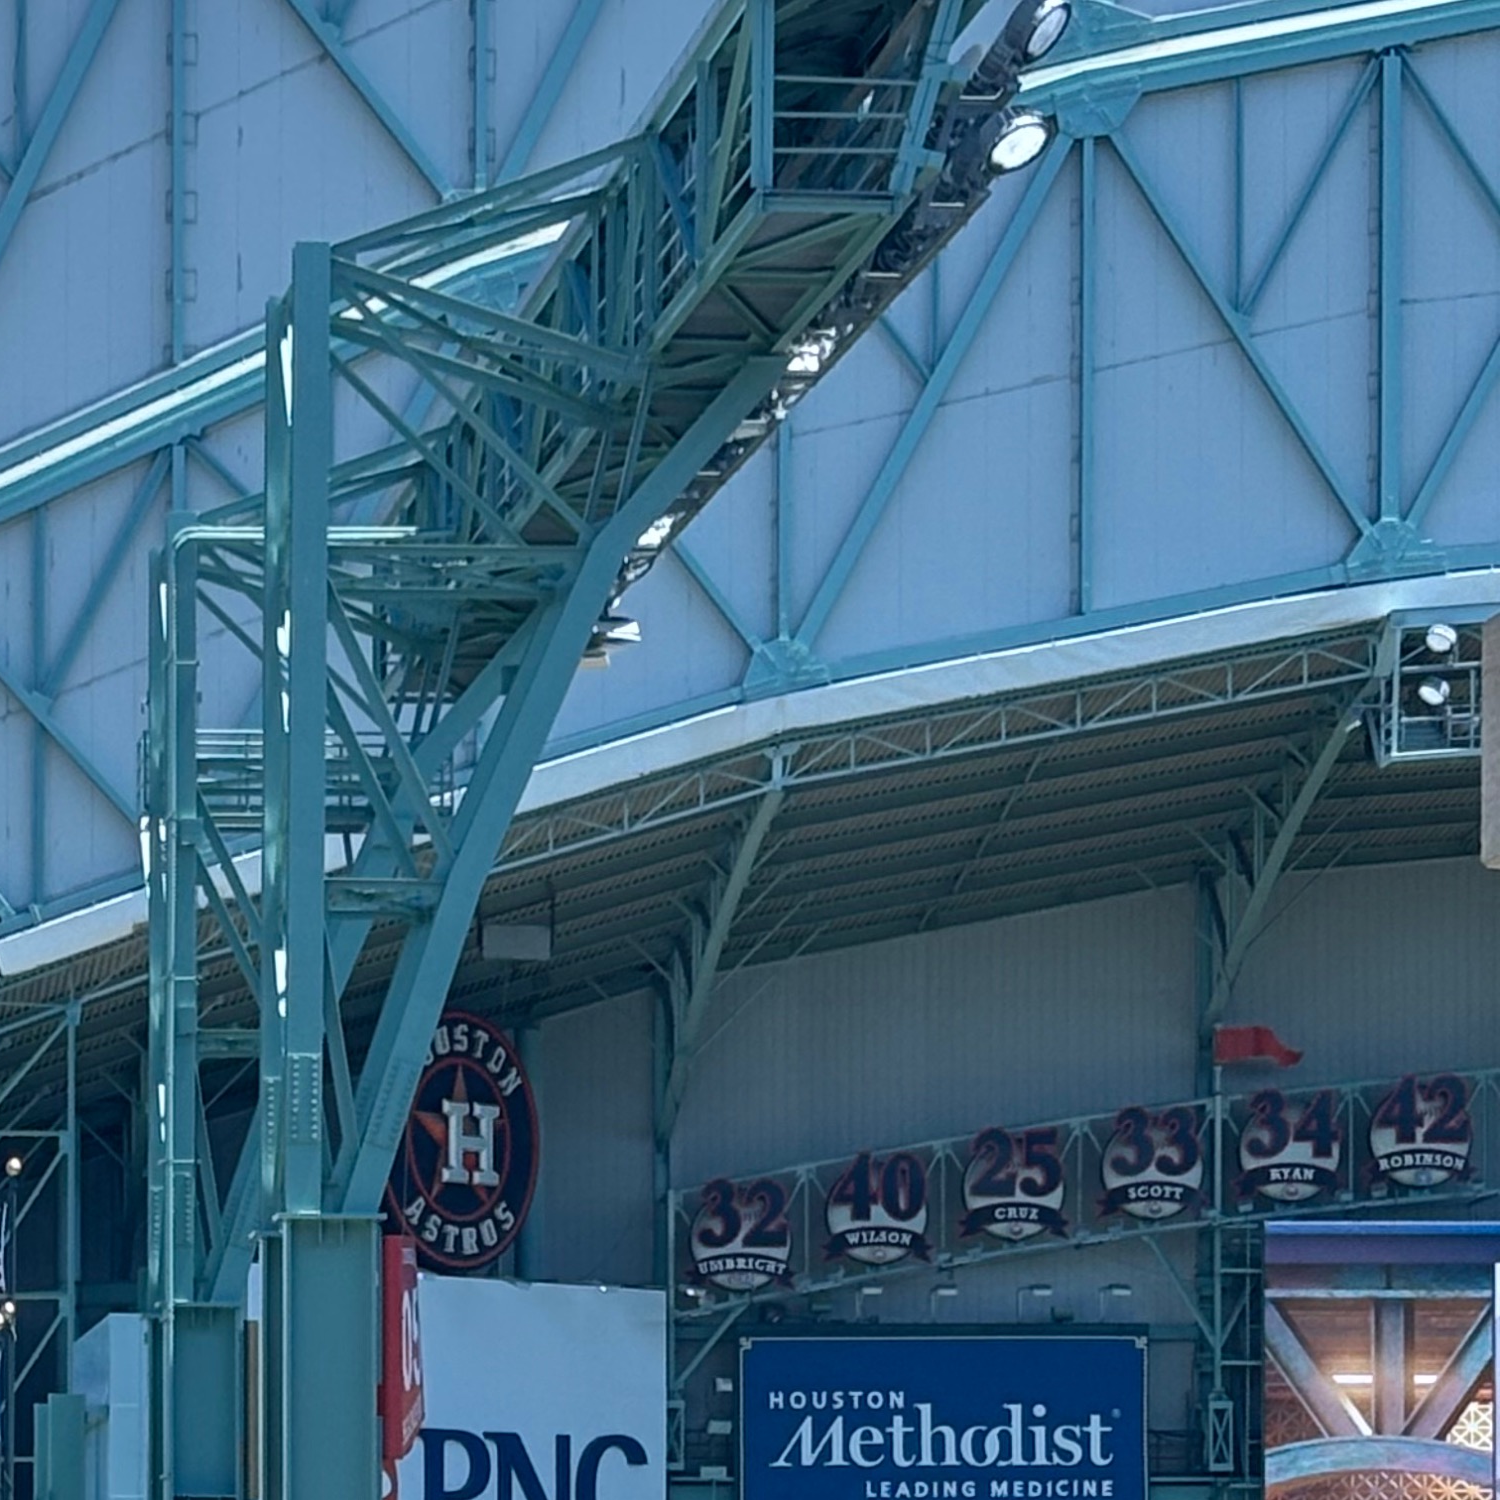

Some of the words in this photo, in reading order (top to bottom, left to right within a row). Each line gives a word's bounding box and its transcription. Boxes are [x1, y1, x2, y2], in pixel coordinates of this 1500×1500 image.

[424, 1024, 522, 1096] USTON
[1110, 1106, 1199, 1177] 33
[1246, 1088, 1340, 1158] 34
[1374, 1073, 1468, 1144] 42
[442, 1098, 500, 1186] H
[968, 1126, 1063, 1197] 25
[1269, 1167, 1315, 1182] RYAN
[1378, 1153, 1466, 1171] ROBINSON
[698, 1178, 790, 1248] 32
[830, 1152, 926, 1222] 40
[994, 1206, 1041, 1220] CRUZ
[1127, 1185, 1185, 1200] SCOTT
[404, 1196, 516, 1255] ASTROS
[845, 1229, 914, 1247] WILSON
[768, 1390, 905, 1410] HOUSTON
[769, 1402, 1114, 1468] Methodist
[865, 1480, 977, 1498] LEADING
[990, 1479, 1114, 1497] MEDICINE
